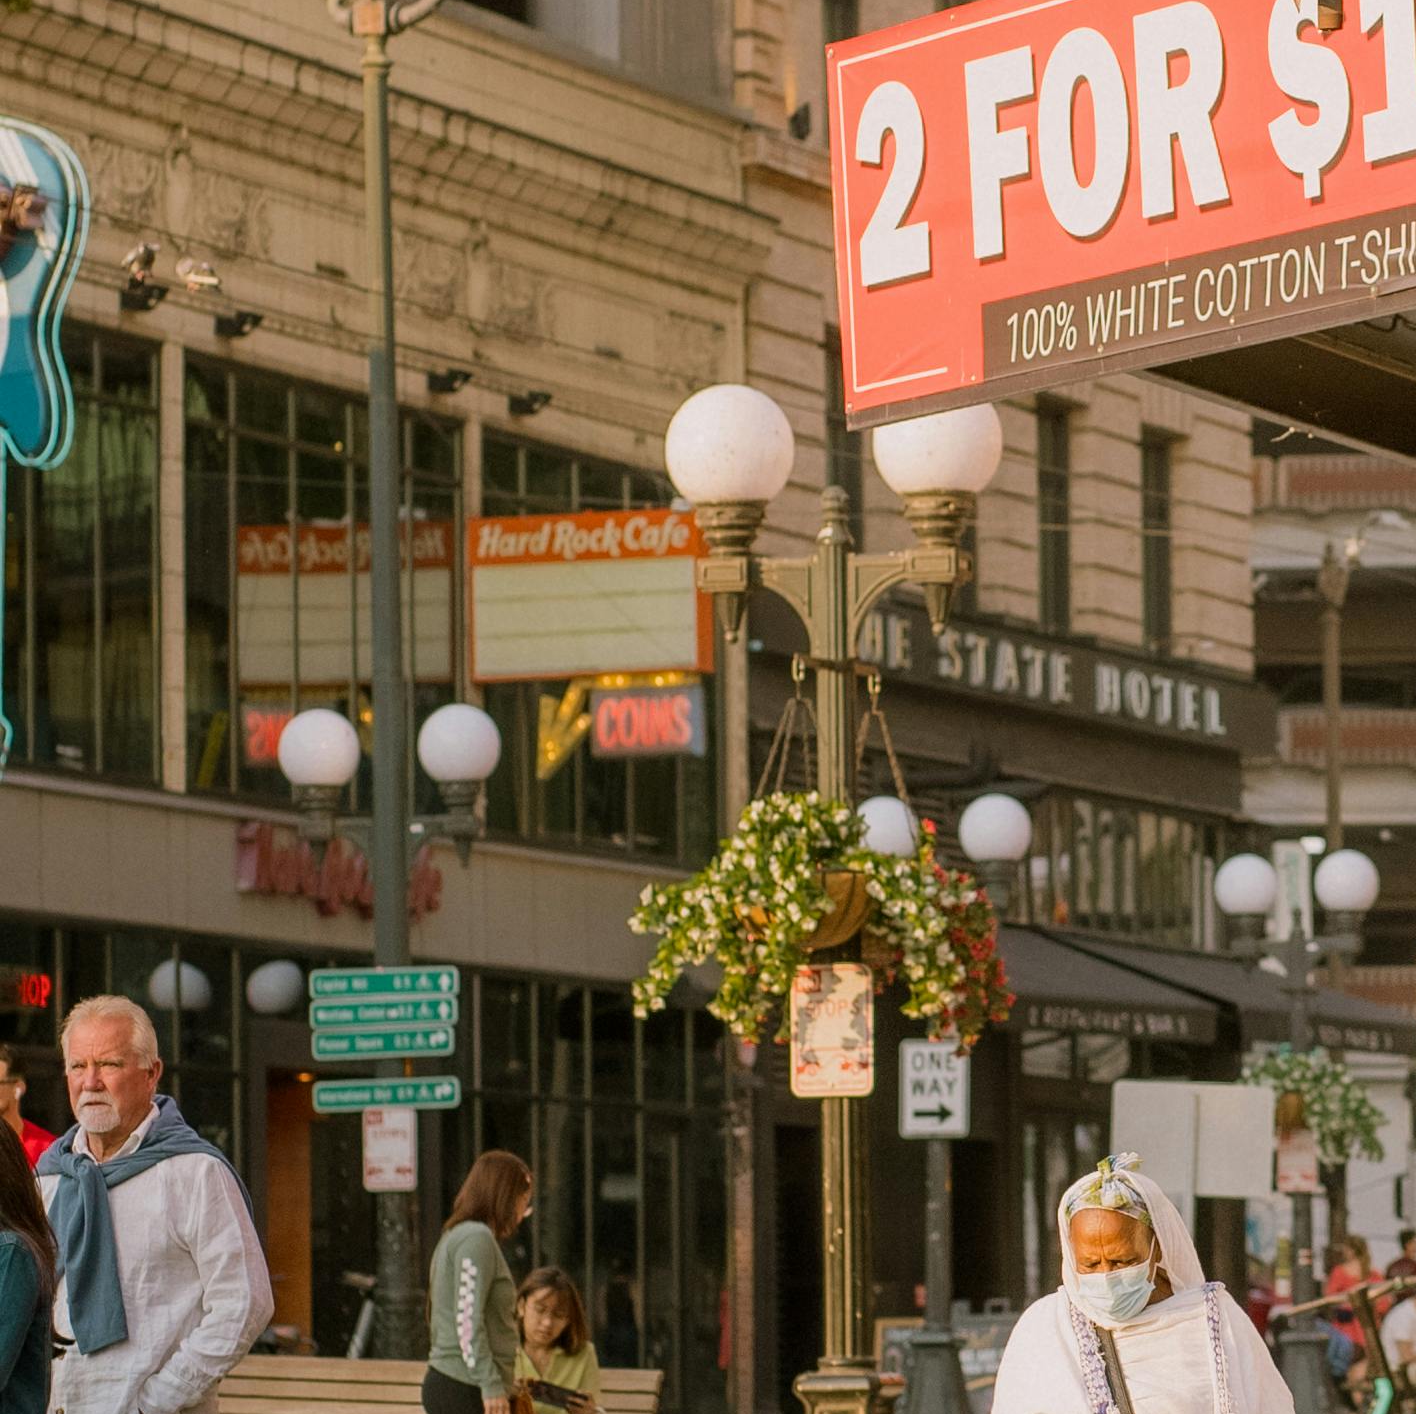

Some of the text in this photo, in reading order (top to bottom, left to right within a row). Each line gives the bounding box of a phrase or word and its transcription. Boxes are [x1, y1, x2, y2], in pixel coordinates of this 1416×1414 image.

[855, 80, 932, 289] 2
[963, 0, 1231, 263] FOR
[1005, 293, 1078, 364] 100%
[1085, 273, 1187, 355] WHITE
[1193, 240, 1327, 324] COTTON
[477, 515, 690, 561] Hard Rock Cafe
[936, 627, 1073, 705] STATE
[1095, 662, 1228, 736] HOTEL
[912, 1051, 958, 1073] ONE
[912, 1078, 957, 1095] WAY
